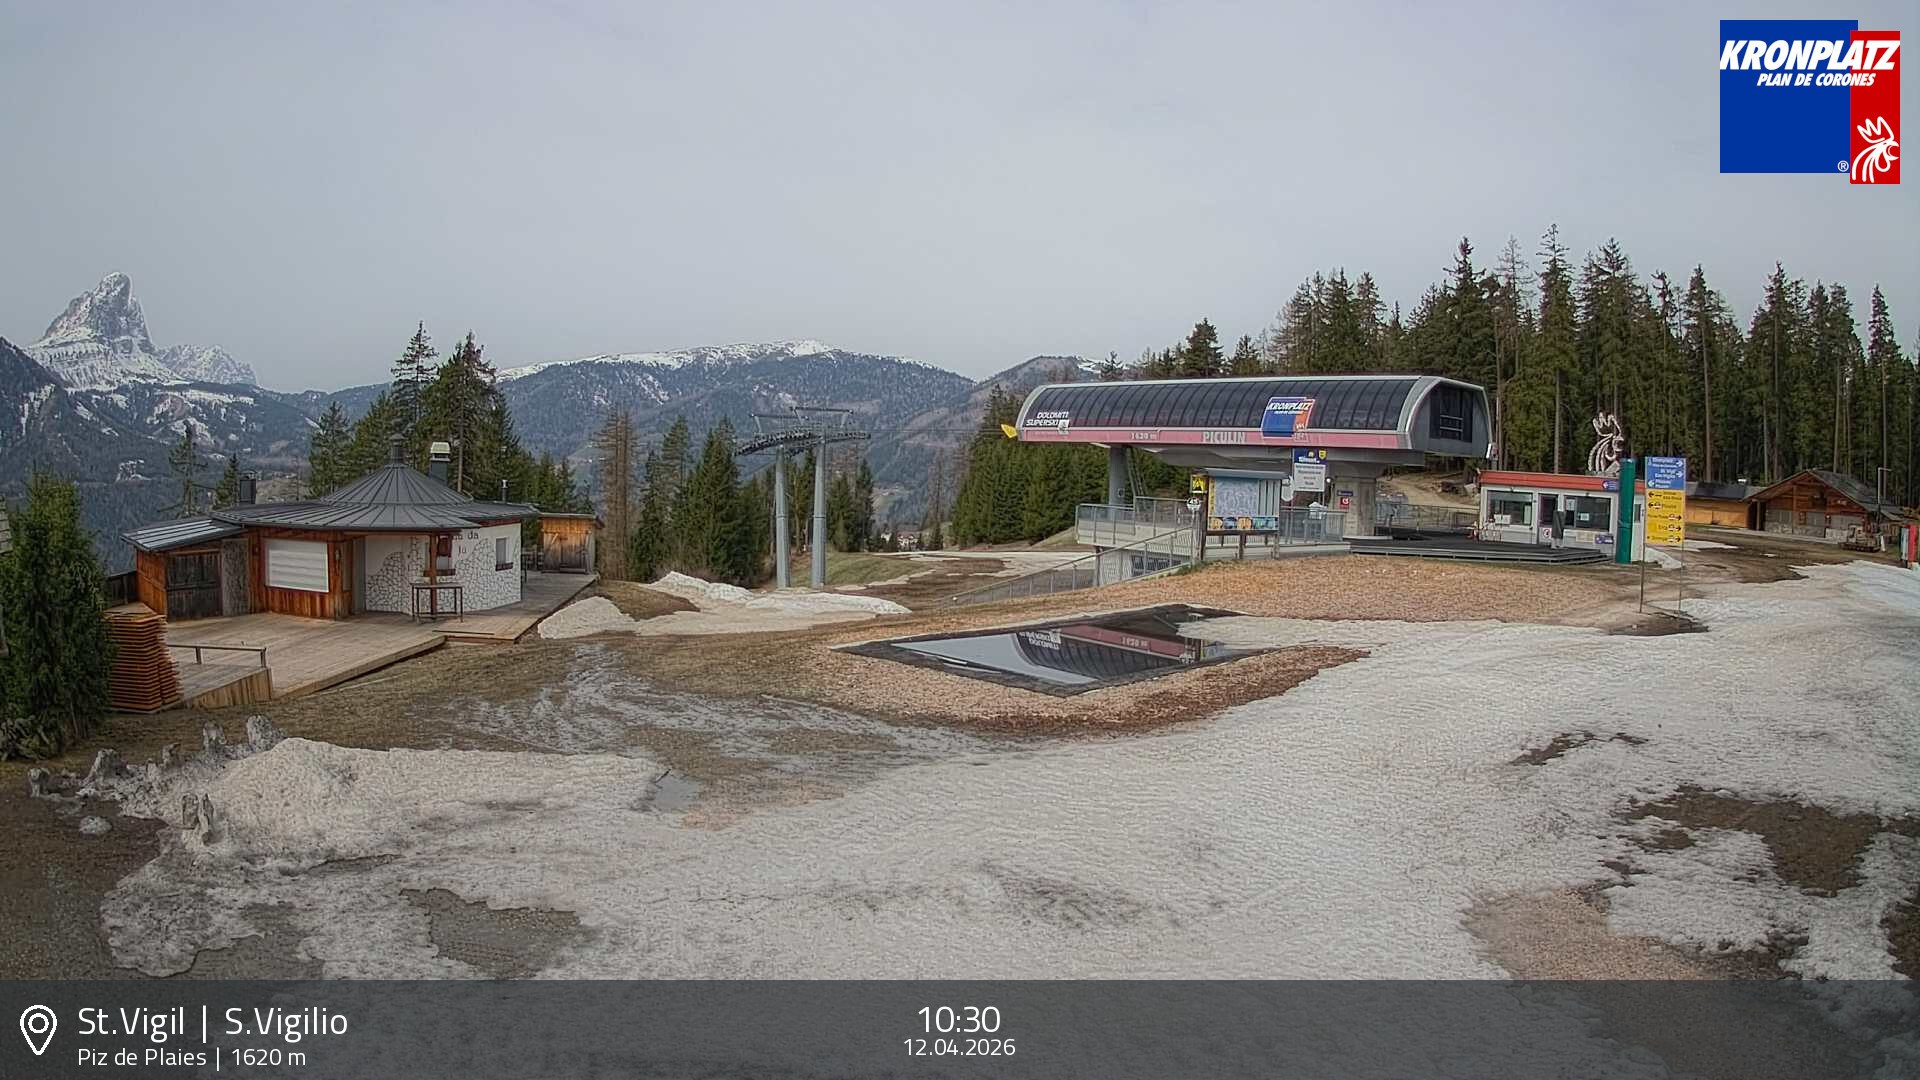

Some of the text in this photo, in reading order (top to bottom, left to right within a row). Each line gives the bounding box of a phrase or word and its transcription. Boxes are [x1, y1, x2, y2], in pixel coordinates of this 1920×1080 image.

[1266, 402, 1313, 410] KRONPLATZ
[1036, 411, 1069, 419] DOLOMITI
[1130, 432, 1148, 440] 1620
[1202, 432, 1246, 444] PICULIN
